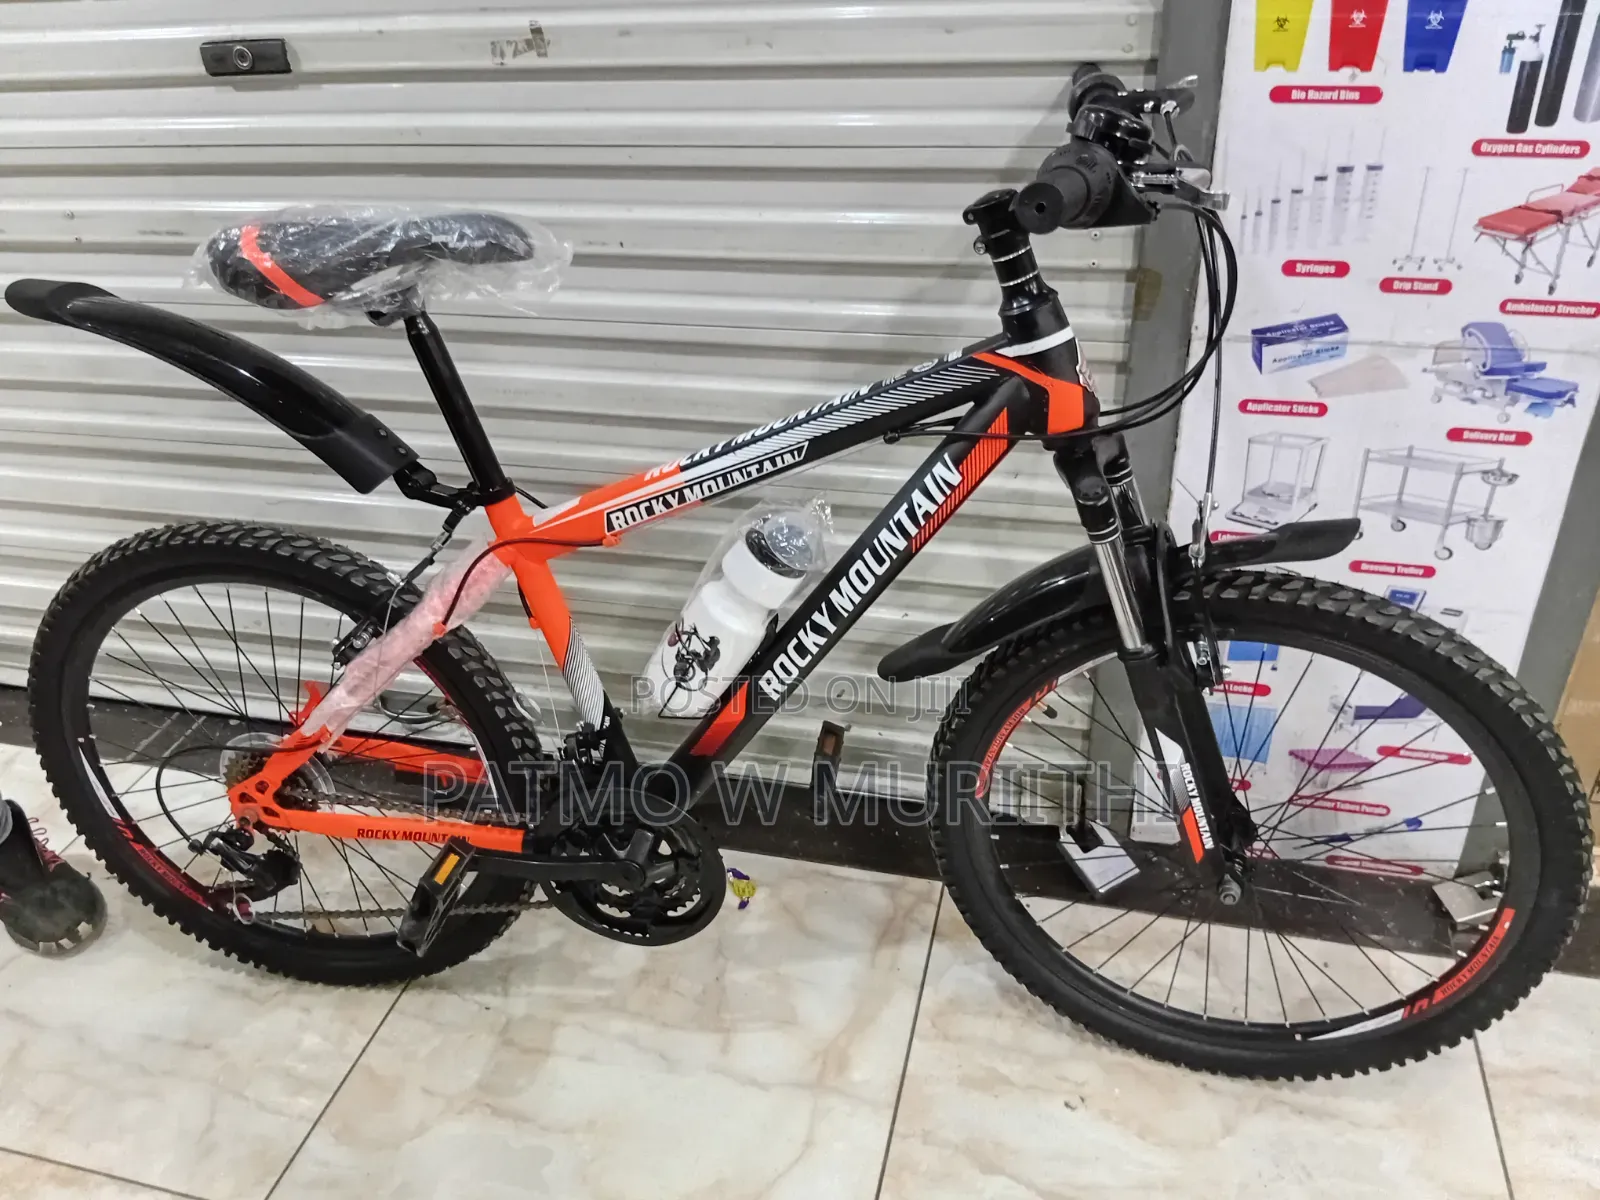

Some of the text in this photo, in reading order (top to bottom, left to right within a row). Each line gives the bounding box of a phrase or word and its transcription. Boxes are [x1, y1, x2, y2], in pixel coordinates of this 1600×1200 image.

[1291, 89, 1360, 100] Bio Hazard Bins
[1480, 142, 1581, 154] Oxygen Gas Cylinders
[1295, 262, 1336, 274] Syringes
[1393, 280, 1439, 291] Drip Stand
[1506, 302, 1555, 312] Ambulance
[1247, 402, 1319, 414] Applicator Sticks
[1463, 430, 1516, 442] Delivery Bed
[609, 451, 801, 531] ROCKY MOUNTAIN
[1397, 565, 1424, 576] Trolley
[758, 453, 963, 701] ROCKY MOUNTAIN
[1181, 763, 1215, 849] ROCKY MOUNTAIN
[357, 828, 400, 841] ROCKY
